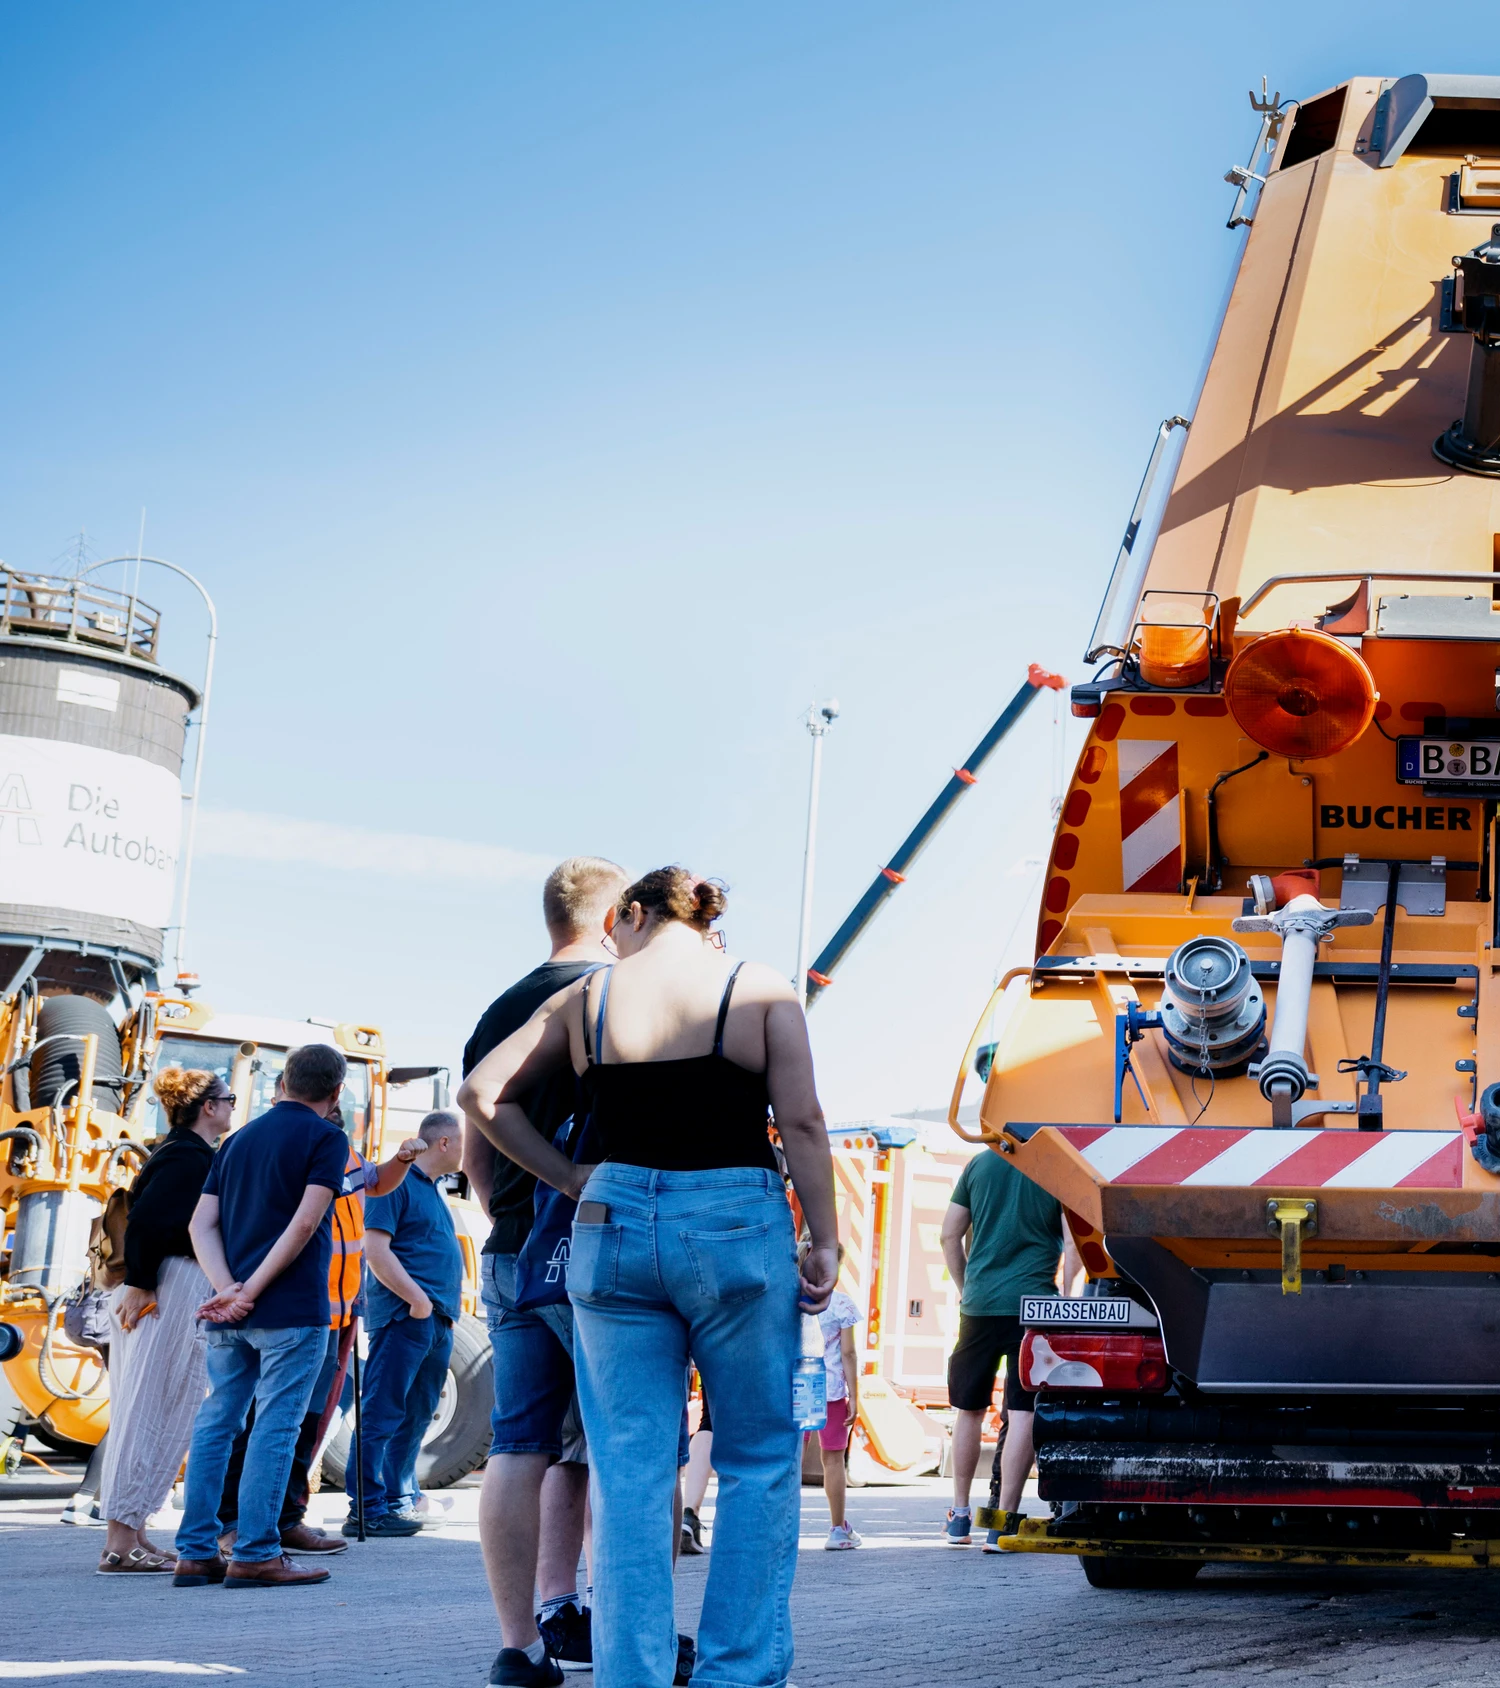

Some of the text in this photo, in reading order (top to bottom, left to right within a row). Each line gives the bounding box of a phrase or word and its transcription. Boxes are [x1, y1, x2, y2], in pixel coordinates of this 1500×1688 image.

[1405, 762, 1414, 771] D
[1423, 745, 1445, 774] B
[67, 783, 119, 819] Die
[1320, 805, 1472, 830] BUCHER
[1027, 1301, 1126, 1320] STRASSENBAU
